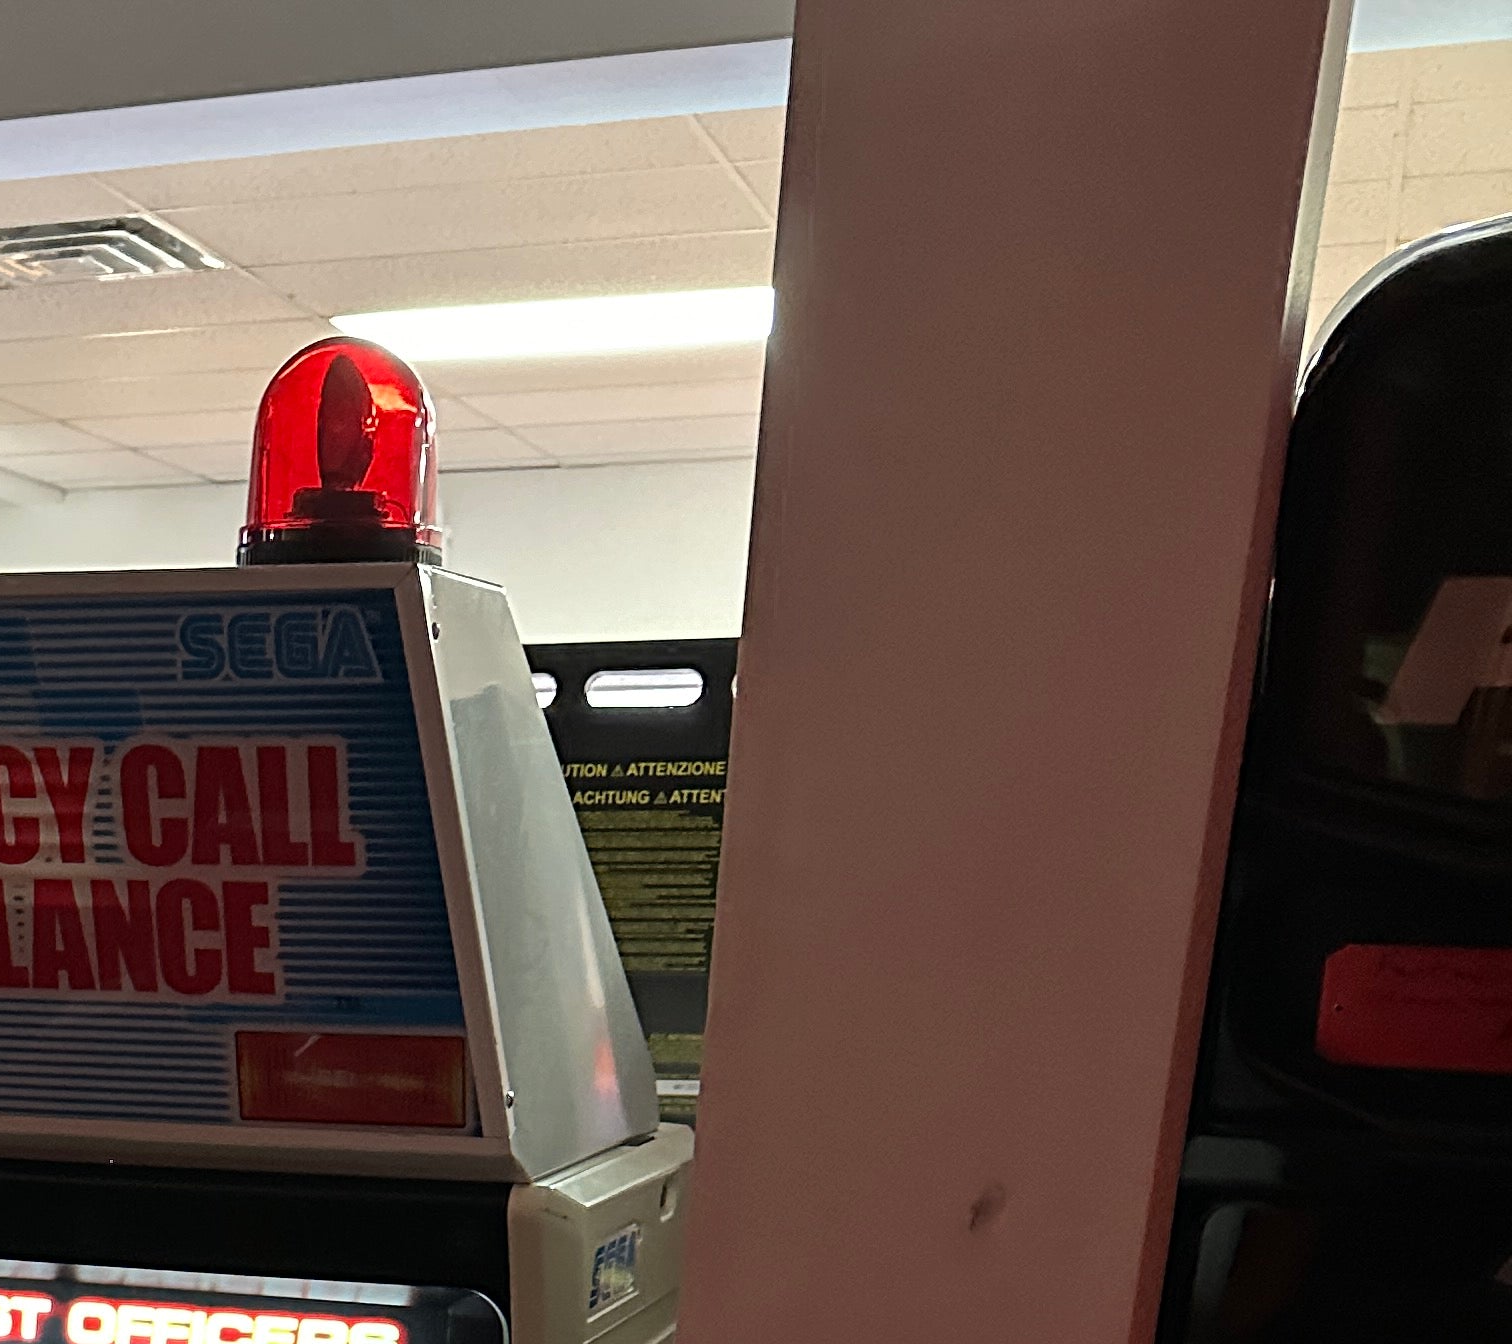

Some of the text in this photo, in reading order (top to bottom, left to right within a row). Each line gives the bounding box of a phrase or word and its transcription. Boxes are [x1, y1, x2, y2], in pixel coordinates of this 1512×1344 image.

[179, 611, 383, 683] SEGA
[561, 760, 727, 778] UTION ATTENZIONE
[119, 742, 357, 868] CALL
[573, 788, 727, 805] ACHTUNG ATTEN
